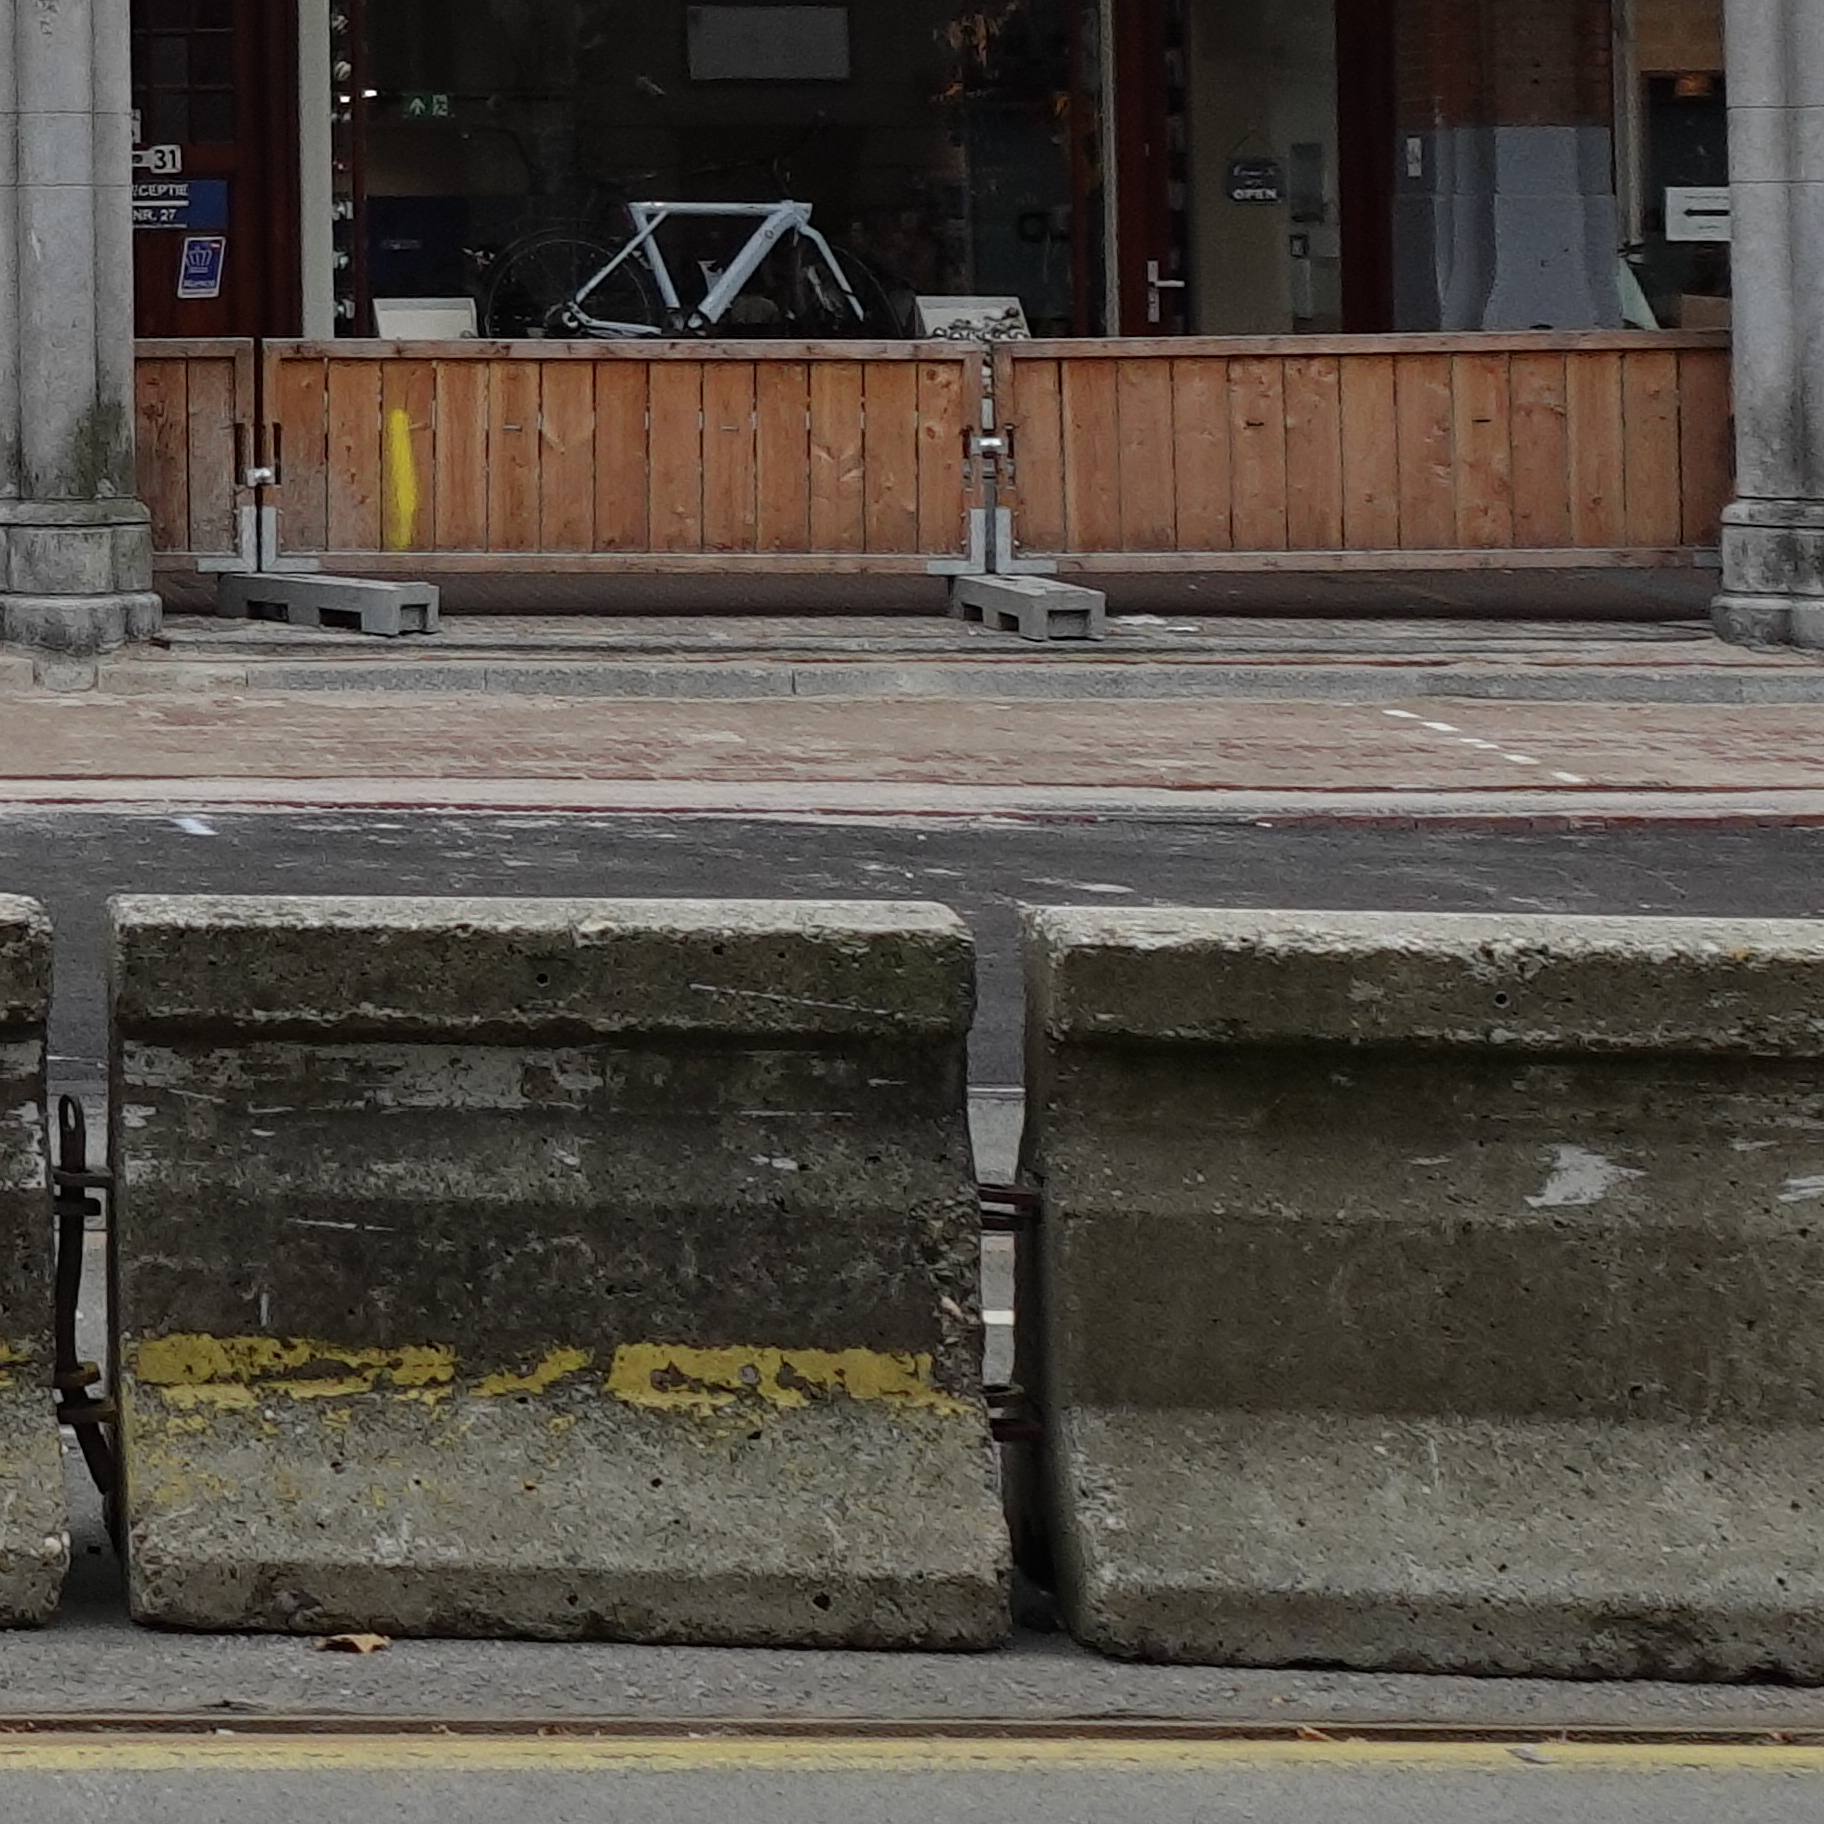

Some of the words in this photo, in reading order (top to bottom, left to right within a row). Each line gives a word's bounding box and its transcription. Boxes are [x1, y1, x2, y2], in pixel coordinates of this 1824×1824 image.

[155, 150, 176, 169] 31
[1232, 188, 1277, 200] OPEN
[160, 209, 177, 221] 27
